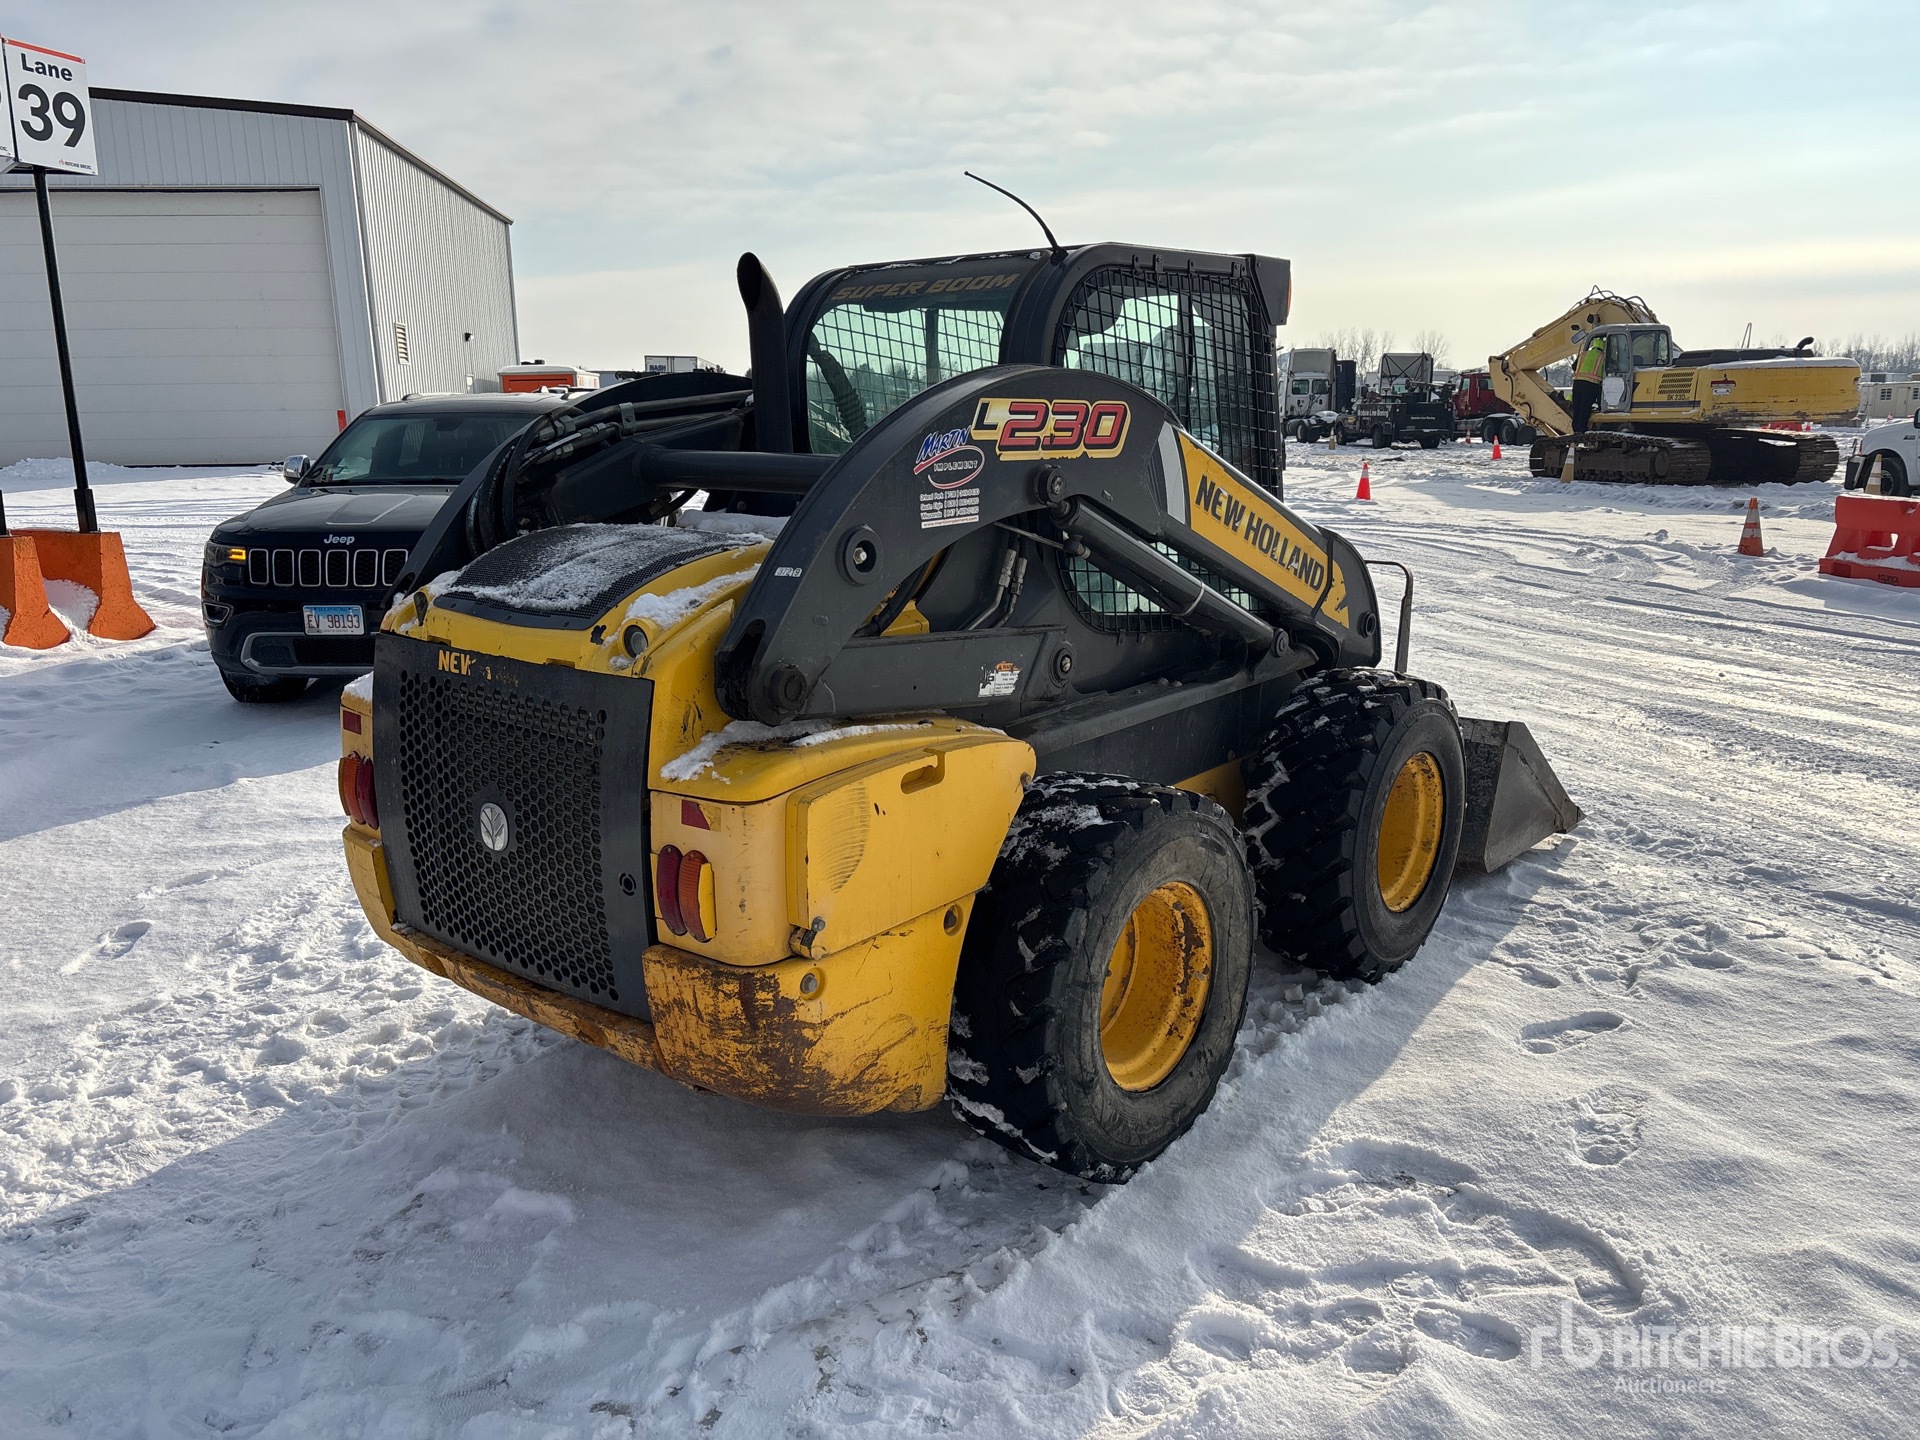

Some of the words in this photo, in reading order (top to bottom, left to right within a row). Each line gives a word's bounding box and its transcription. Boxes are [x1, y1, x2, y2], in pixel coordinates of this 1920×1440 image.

[21, 53, 72, 81] Lane
[18, 83, 86, 148] 39
[831, 281, 928, 301] SUPER
[925, 273, 1021, 294] BOOM
[649, 364, 667, 372] NASH
[915, 425, 972, 464] MARTIN
[934, 460, 978, 472] IMPLEMENT
[323, 534, 355, 545] Jeep
[1195, 474, 1246, 533] NEW
[1244, 512, 1325, 592] HOLLAND
[307, 614, 320, 629] EV
[327, 614, 361, 629] 98193
